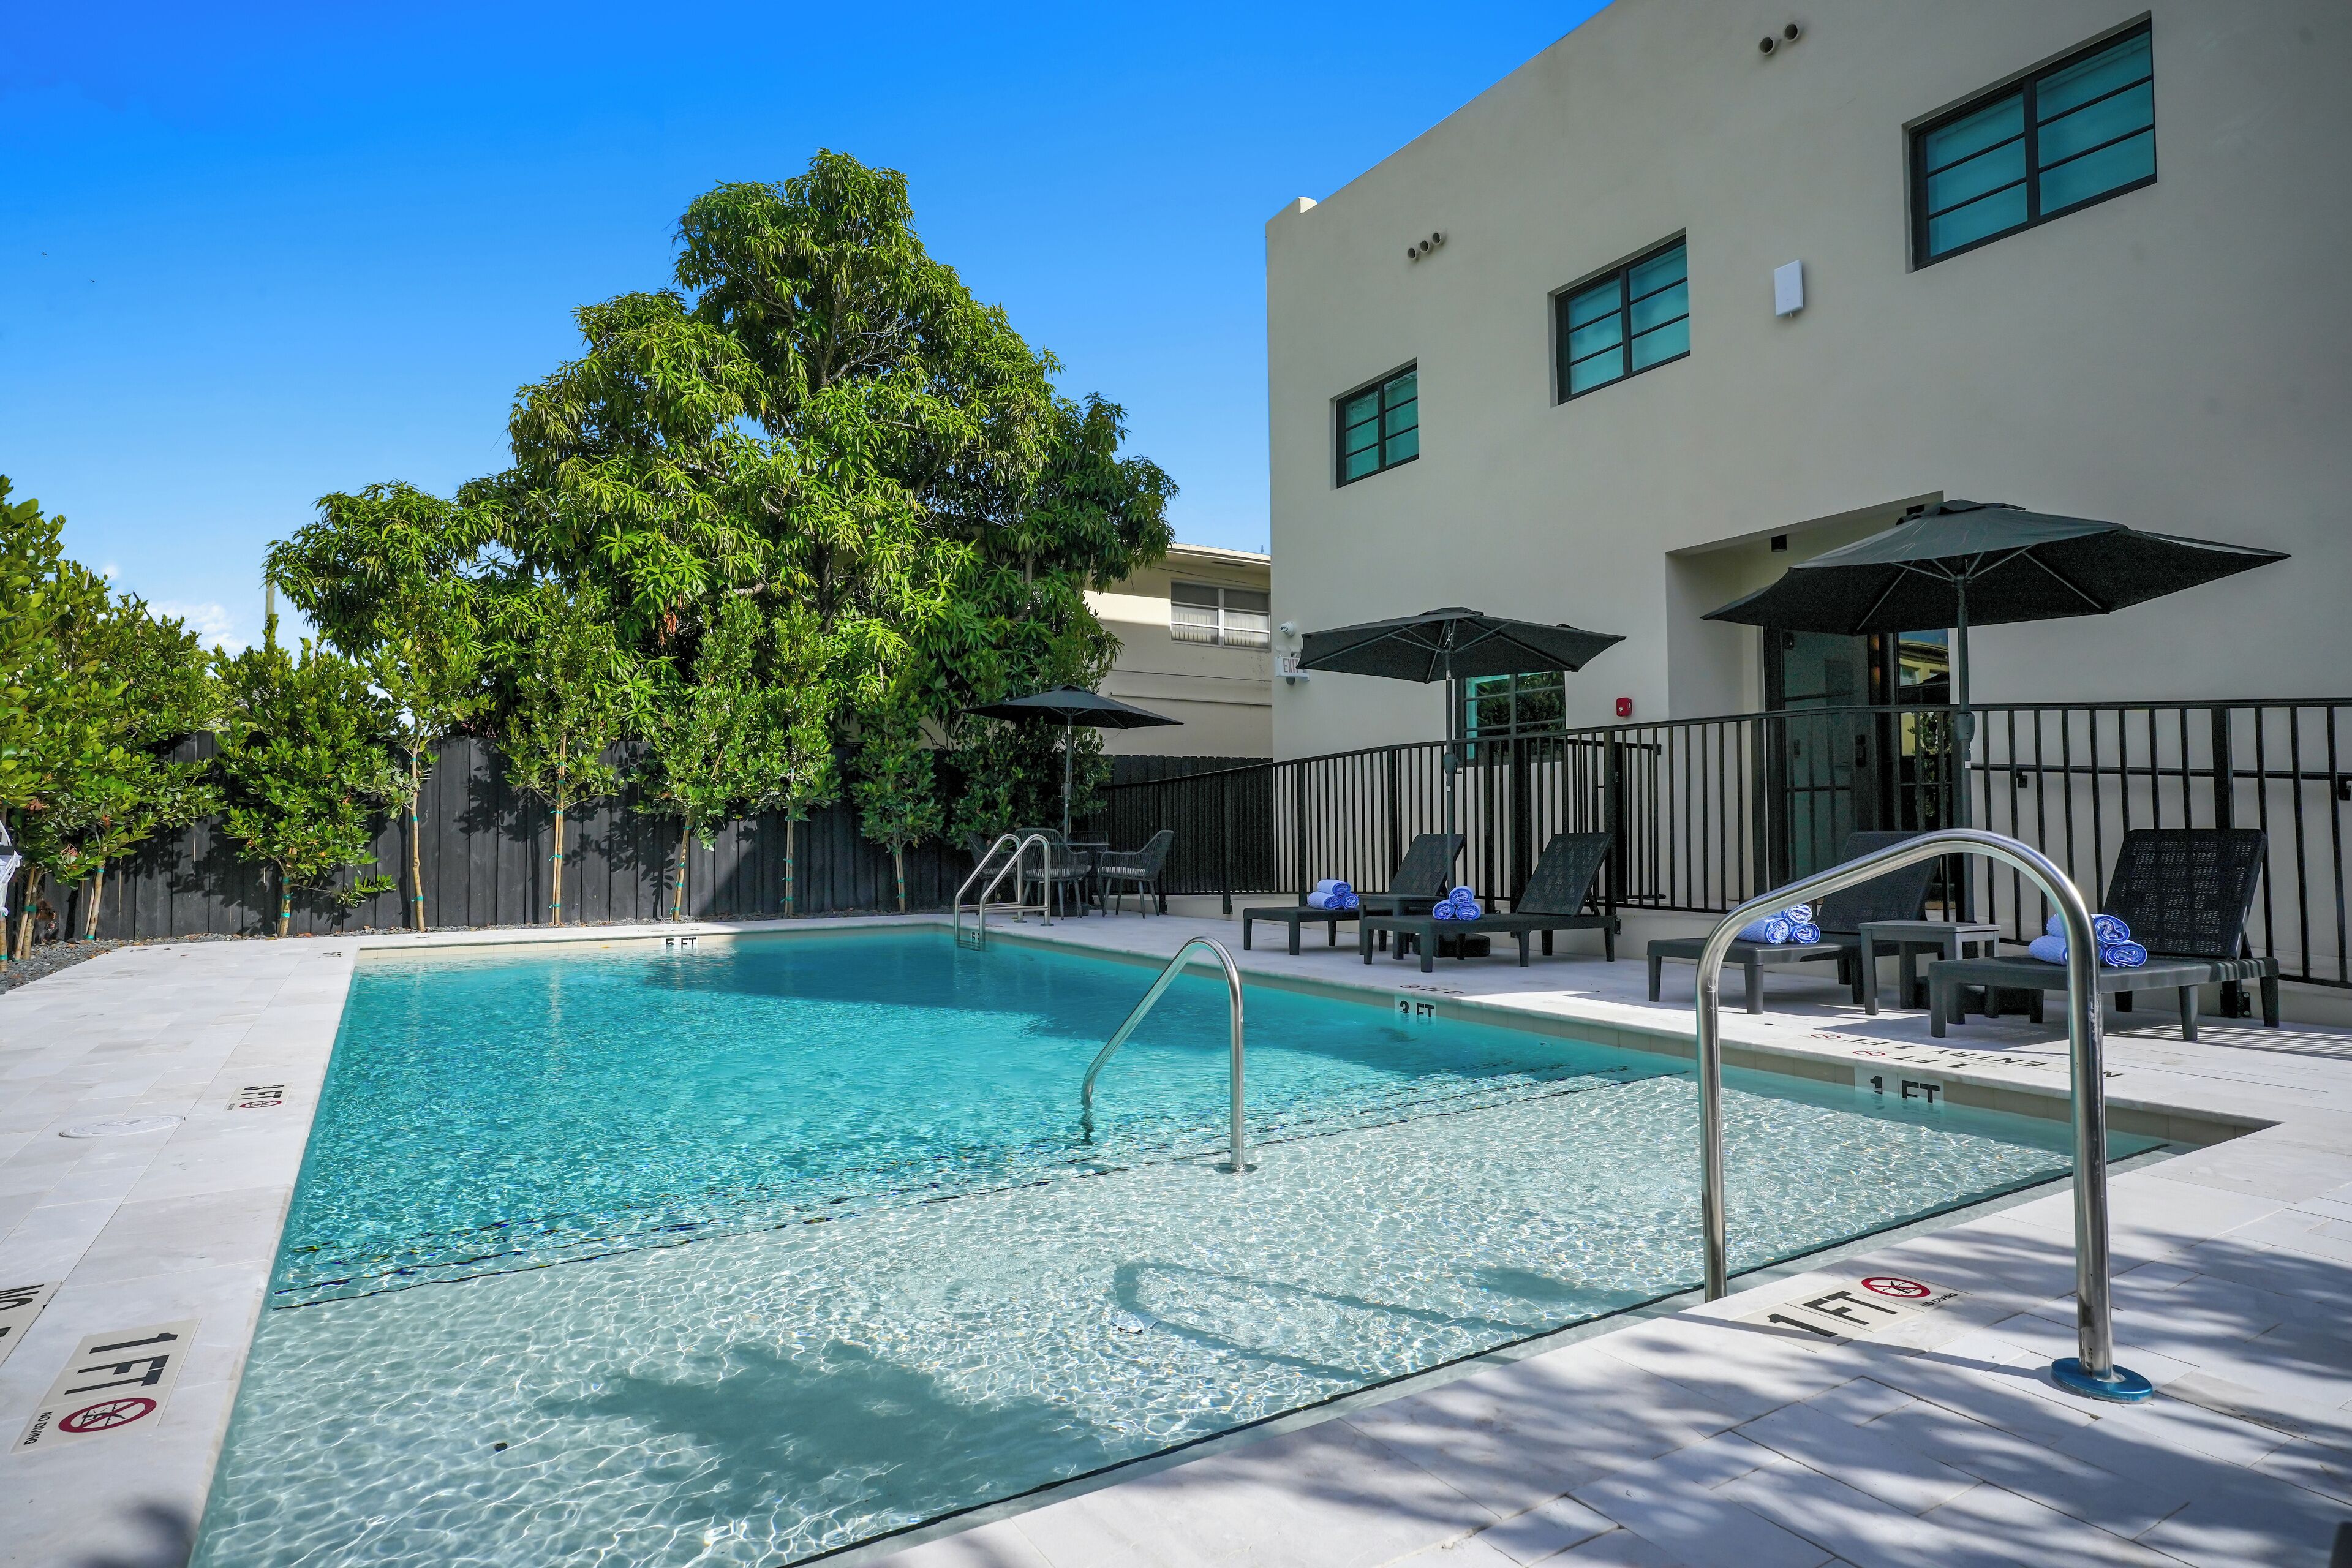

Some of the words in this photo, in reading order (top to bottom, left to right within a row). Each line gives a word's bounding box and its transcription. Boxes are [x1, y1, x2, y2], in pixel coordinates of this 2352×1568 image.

[1283, 658, 1299, 673] EXIT
[681, 937, 696, 949] FT
[1417, 1003, 1434, 1018] FT
[1926, 1050, 2048, 1067] ENTRY
[238, 1090, 283, 1100] FT
[1902, 1080, 1940, 1104] FT
[1931, 1292, 1959, 1303] DIVING
[1802, 1291, 1898, 1325] FT
[1768, 1313, 1838, 1337] 1
[89, 1332, 178, 1354] 1
[64, 1354, 170, 1395] FT
[37, 1411, 54, 1422] NO
[23, 1422, 48, 1446] DIVING
